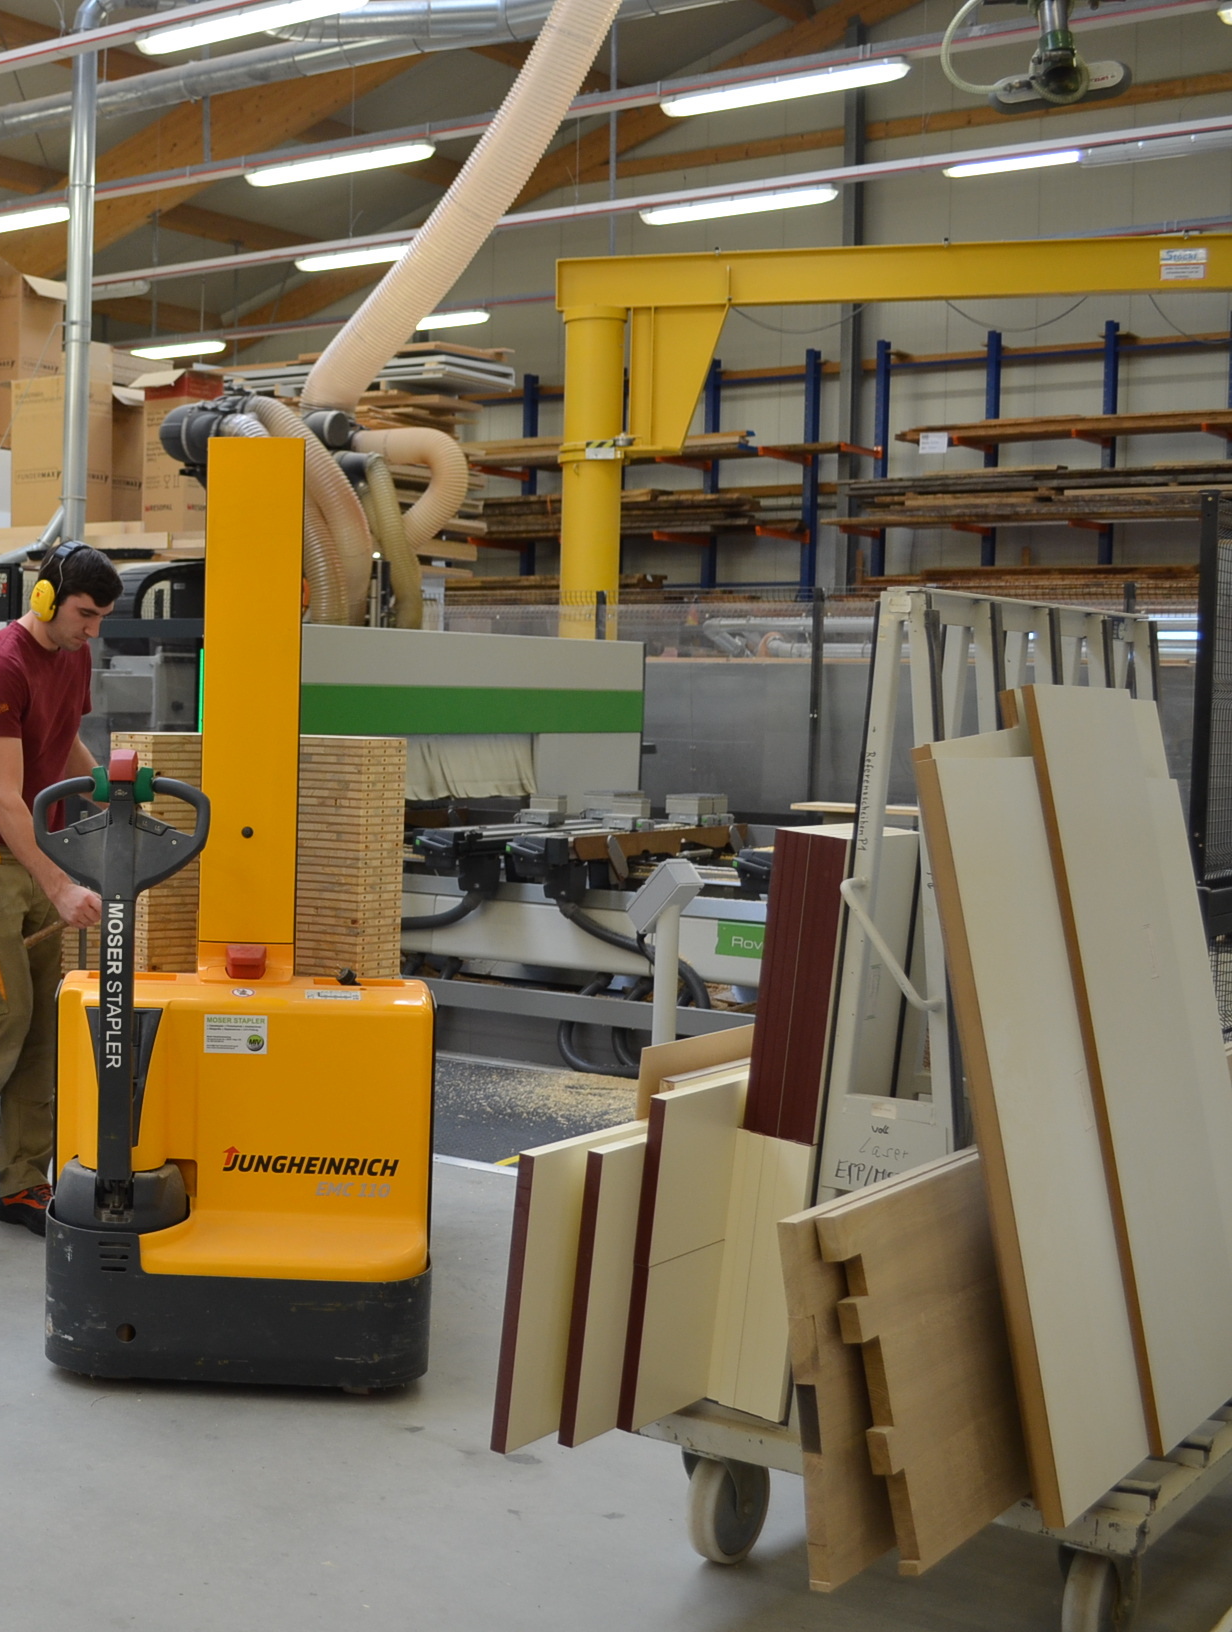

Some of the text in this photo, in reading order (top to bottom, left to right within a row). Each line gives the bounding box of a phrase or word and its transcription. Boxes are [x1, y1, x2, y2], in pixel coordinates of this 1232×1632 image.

[731, 935, 763, 949] Rov
[105, 903, 124, 1069] MOSER STAPLER
[223, 1153, 399, 1177] JUNGHEINRICH
[315, 1181, 391, 1198] EMC 110
